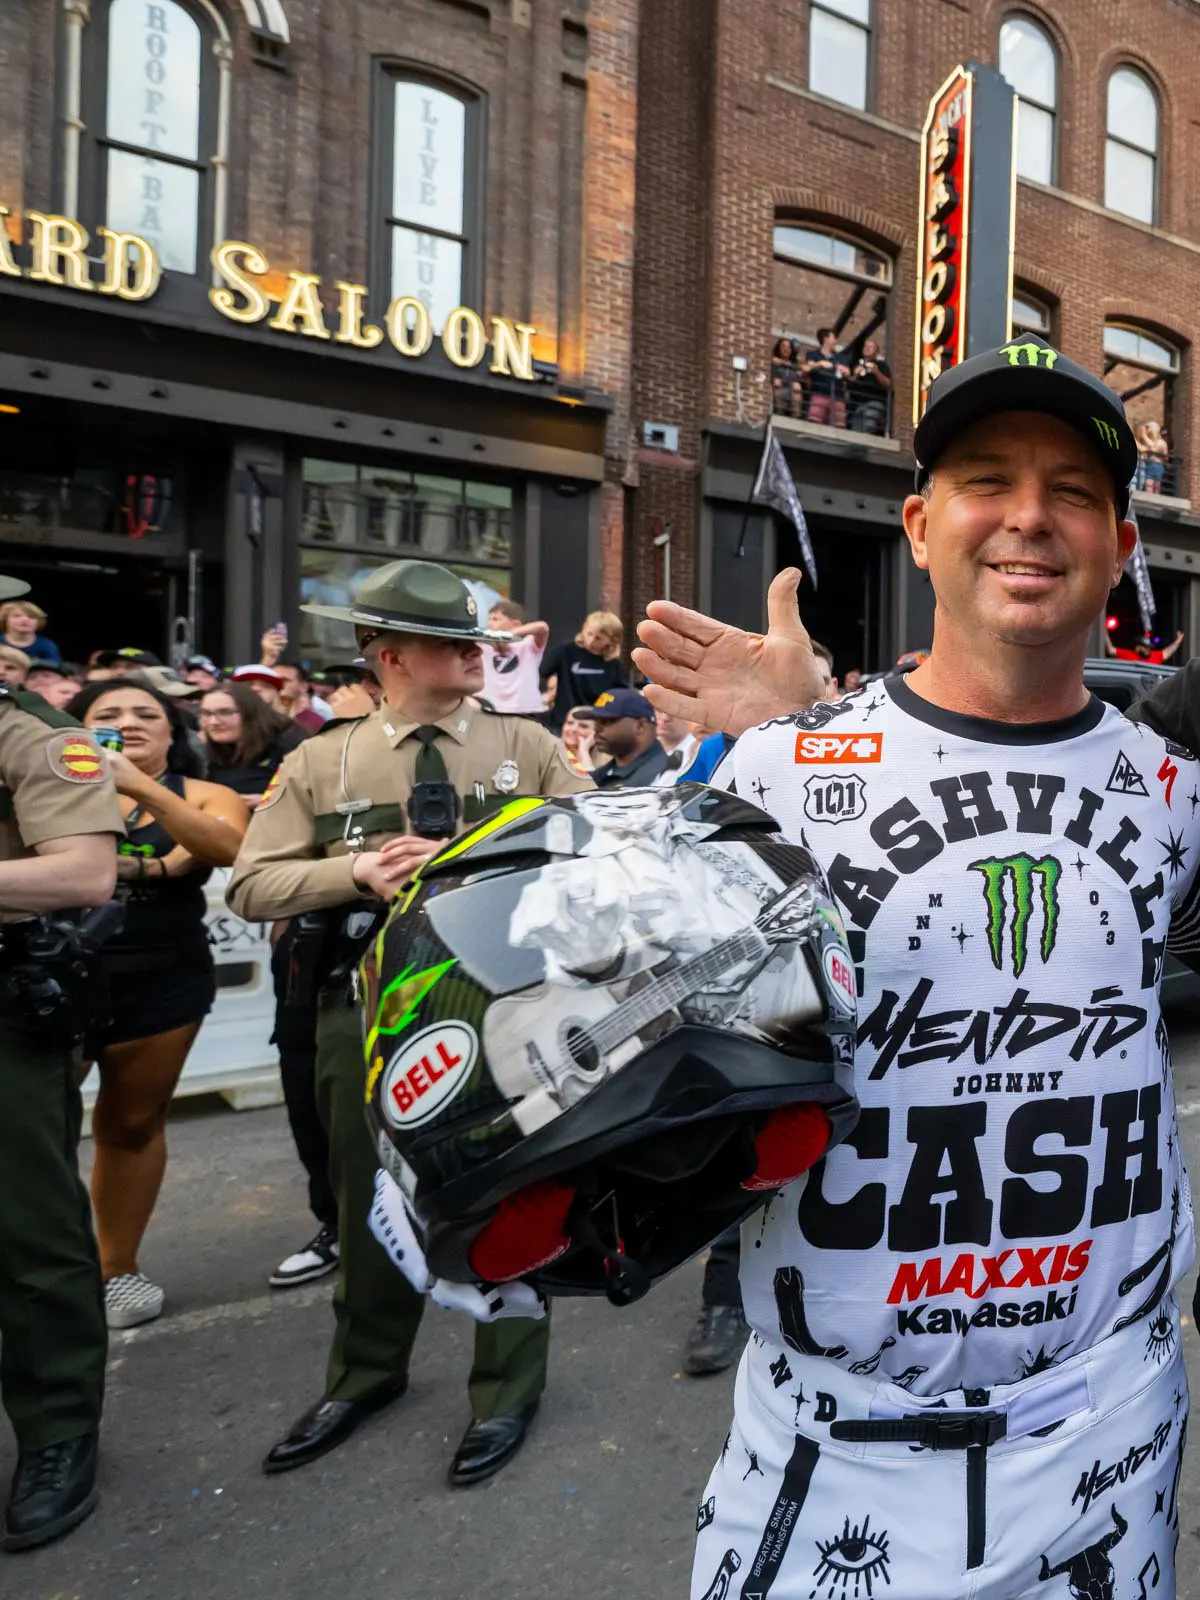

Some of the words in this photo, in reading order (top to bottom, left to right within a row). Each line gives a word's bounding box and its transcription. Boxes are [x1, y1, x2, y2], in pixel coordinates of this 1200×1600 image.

[210, 241, 537, 380] SALOON
[831, 955, 856, 998] BEL
[391, 1041, 463, 1115] BELL
[953, 1070, 1064, 1097] JOHNNY
[798, 1083, 1161, 1251] CASH
[886, 1239, 1094, 1304] MAXXIS
[897, 1284, 1079, 1338] Kawasaki
[753, 1533, 776, 1578] BREATHE
[771, 1496, 789, 1529] SMILE
[769, 1500, 799, 1563] TRANSFORM
